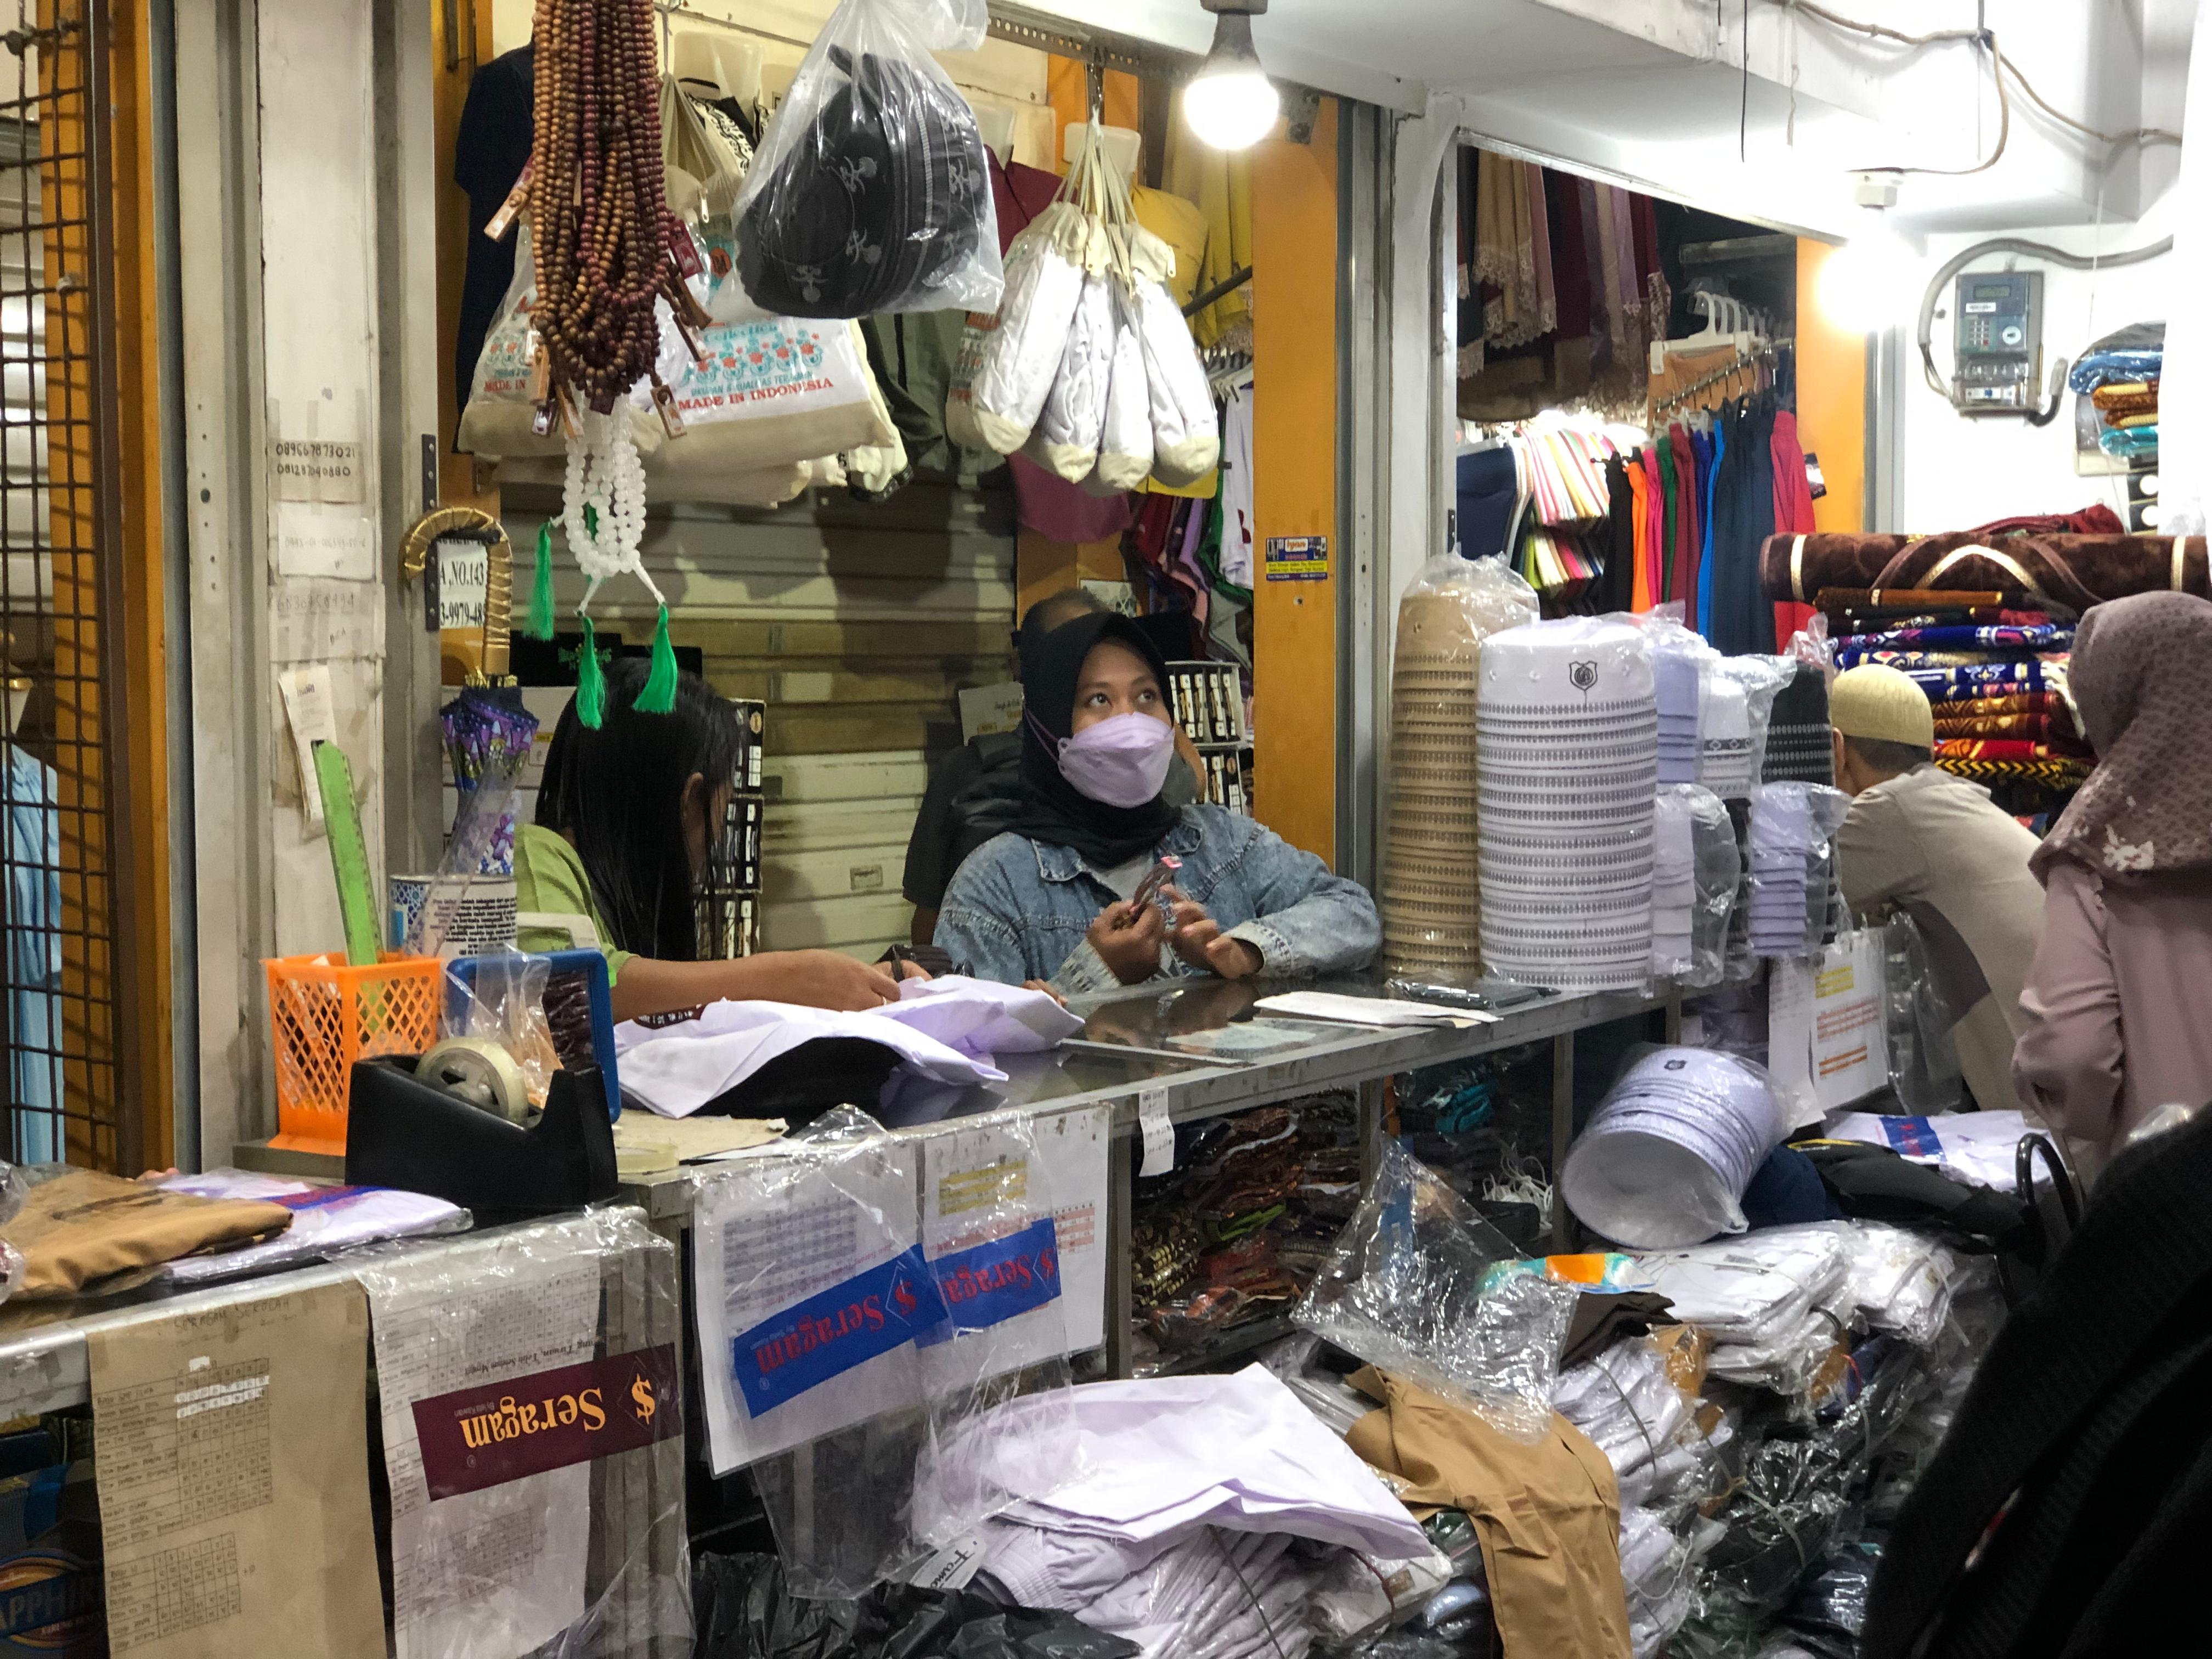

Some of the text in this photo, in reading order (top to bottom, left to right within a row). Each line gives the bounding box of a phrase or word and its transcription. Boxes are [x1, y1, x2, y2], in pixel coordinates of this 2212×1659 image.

[677, 377, 834, 411] MADE IN INDONESIA
[937, 1255, 1032, 1306] Seraga
[755, 1295, 884, 1373] Seragam
[459, 1388, 606, 1448] Seragam
